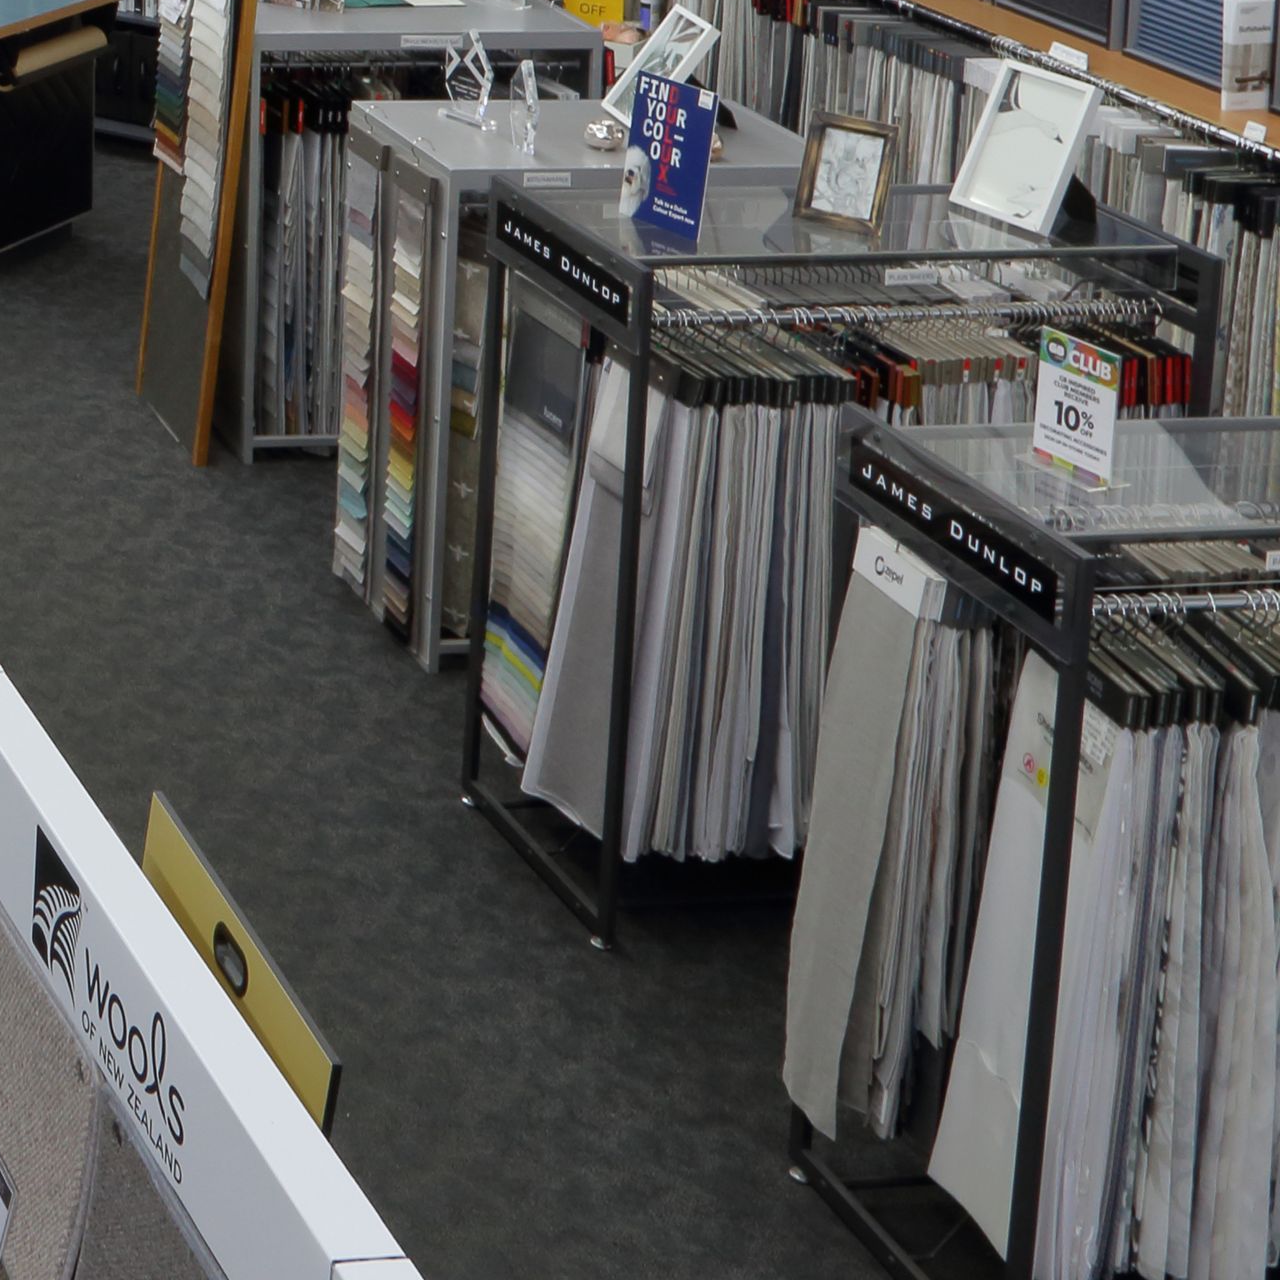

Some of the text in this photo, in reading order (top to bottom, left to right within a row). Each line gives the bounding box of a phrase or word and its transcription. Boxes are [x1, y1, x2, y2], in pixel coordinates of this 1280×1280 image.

[580, 3, 607, 17] OFF
[640, 76, 679, 106] FIND
[647, 98, 687, 129] YOUR
[650, 141, 682, 168] OUR
[653, 205, 667, 216] Colour
[669, 210, 684, 222] Expert
[654, 197, 663, 205] Talk
[673, 204, 688, 215] Dulux
[504, 221, 620, 305] JAMES DUNLOP
[1069, 350, 1112, 381] CLUB
[1054, 380, 1100, 404] CLUB MEMBERS
[1064, 392, 1089, 407] RECEIVE
[1054, 400, 1094, 432] 10%
[1080, 429, 1094, 439] OFF
[862, 464, 1043, 593] JAMES DUNLOP
[81, 1010, 183, 1186] OF NEW ZEALAND
